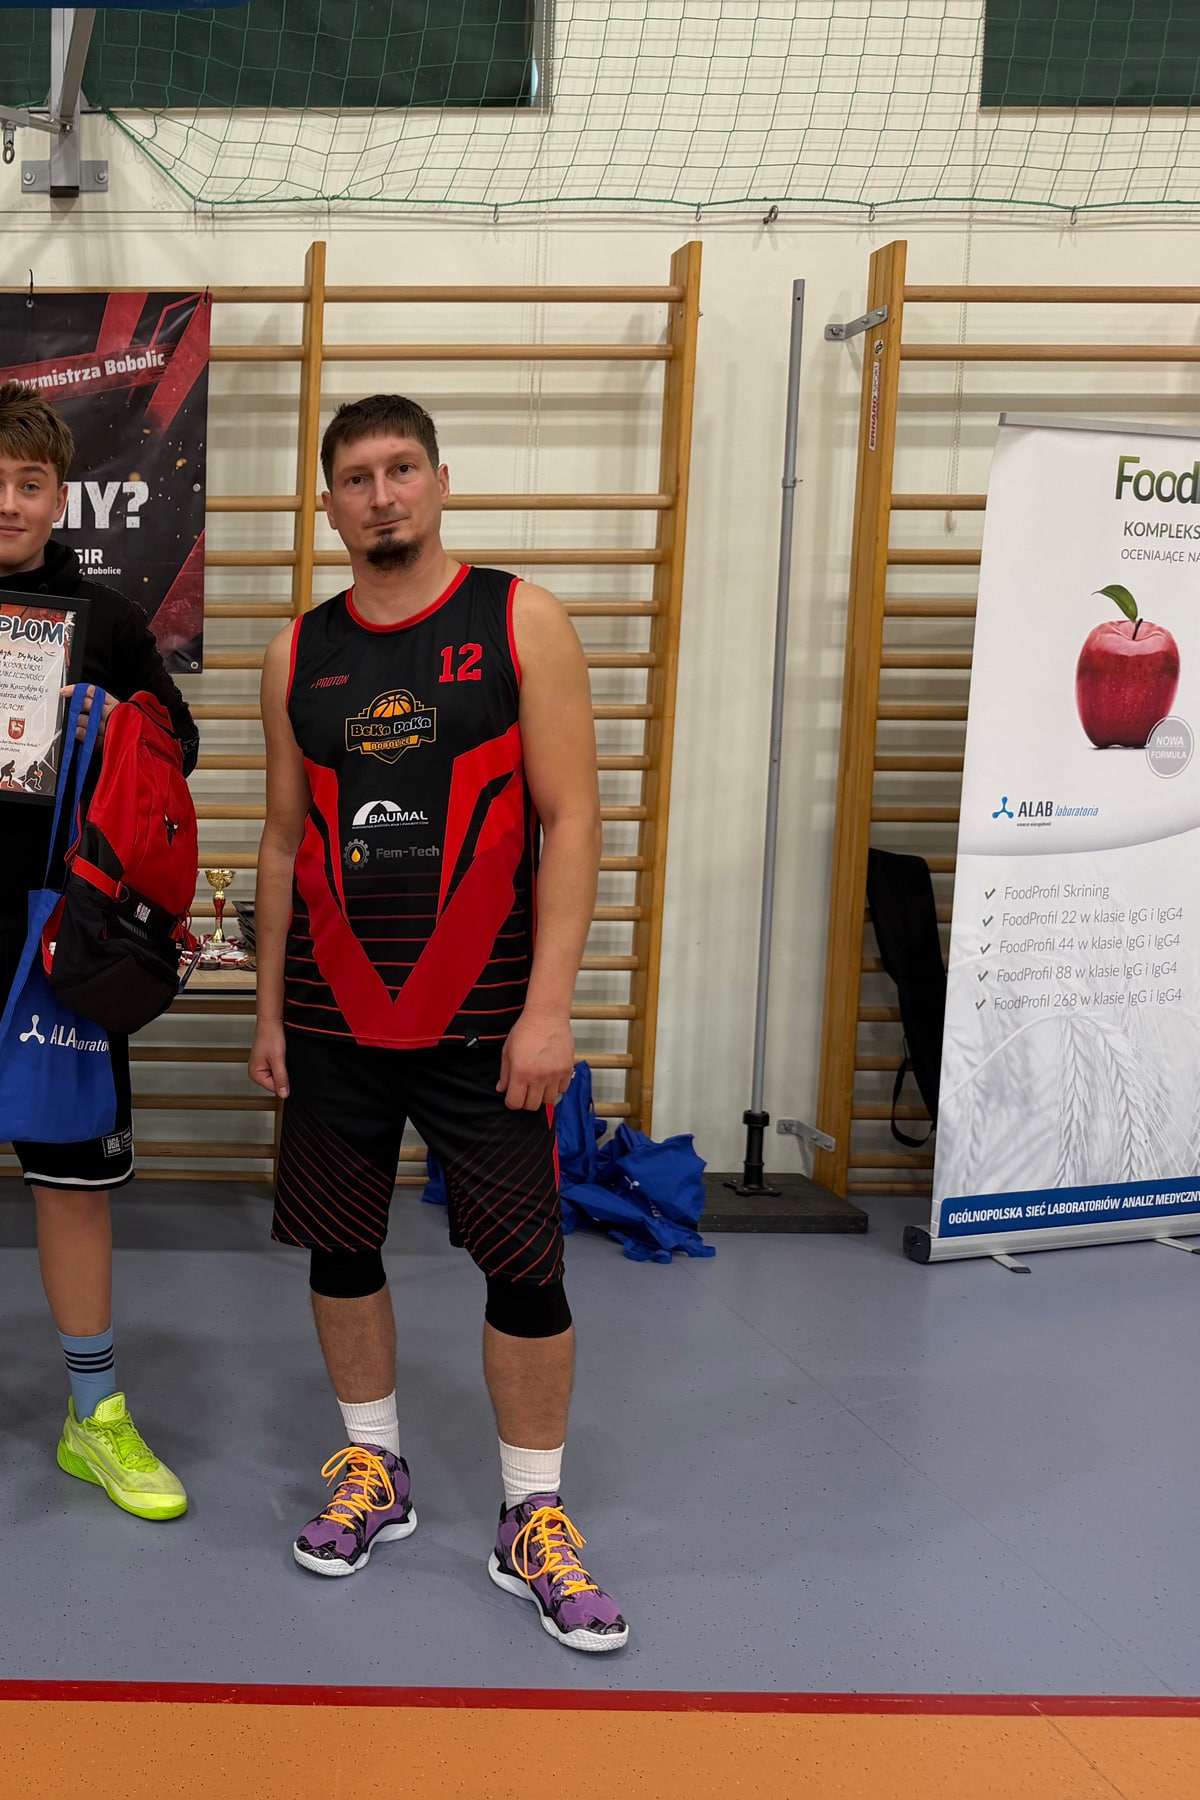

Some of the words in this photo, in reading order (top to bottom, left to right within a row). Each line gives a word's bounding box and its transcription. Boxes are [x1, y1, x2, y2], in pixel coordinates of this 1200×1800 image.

[104, 351, 165, 376] Bobolic
[1115, 455, 1200, 504] Food
[1123, 521, 1200, 540] KOMPLEKS
[1120, 548, 1185, 563] OCENIAJĄCE
[87, 566, 122, 575] Bobolice
[438, 642, 483, 683] 12
[351, 724, 391, 737] BeKa
[393, 716, 432, 735] PaKa
[1156, 735, 1185, 746] NOWA
[368, 810, 428, 824] BAUMAL
[1017, 801, 1054, 818] ALAB
[1054, 804, 1099, 817] laboratoria
[375, 845, 440, 859] Fem-Tech
[1004, 885, 1060, 900] FoodProfil
[1063, 883, 1110, 900] Skrining
[1002, 911, 1057, 926] FoodProfil
[1061, 911, 1077, 924] 22
[1080, 913, 1090, 923] w
[1094, 909, 1125, 923] klasie
[1128, 908, 1148, 924] IgG
[1157, 907, 1183, 923] IgG4
[999, 938, 1055, 954] FoodProfil
[1058, 937, 1074, 950] 44
[1077, 940, 1088, 950] w
[1091, 935, 1122, 950] klasie
[1125, 935, 1145, 950] IgG
[1154, 934, 1181, 950] IgG4
[997, 966, 1052, 982] FoodProfil
[1055, 966, 1072, 979] 88
[1075, 969, 1085, 978] w
[1089, 964, 1120, 978] klasie
[1123, 963, 1142, 979] IgG
[1151, 962, 1178, 978] IgG4
[994, 994, 1049, 1010] FoodProfil
[1054, 993, 1077, 1007] 268
[1080, 996, 1091, 1006] w
[1093, 991, 1124, 1005] klasie
[1127, 990, 1147, 1006] IgG
[1156, 989, 1182, 1005] IgG4
[50, 1024, 77, 1048] ALA
[949, 1207, 1023, 1225] OGÓLNOPOLSKA
[1025, 1203, 1046, 1218] SIEĆ
[1047, 1195, 1122, 1216] LABORATORIÓW
[1122, 1194, 1154, 1209] ANALIZ
